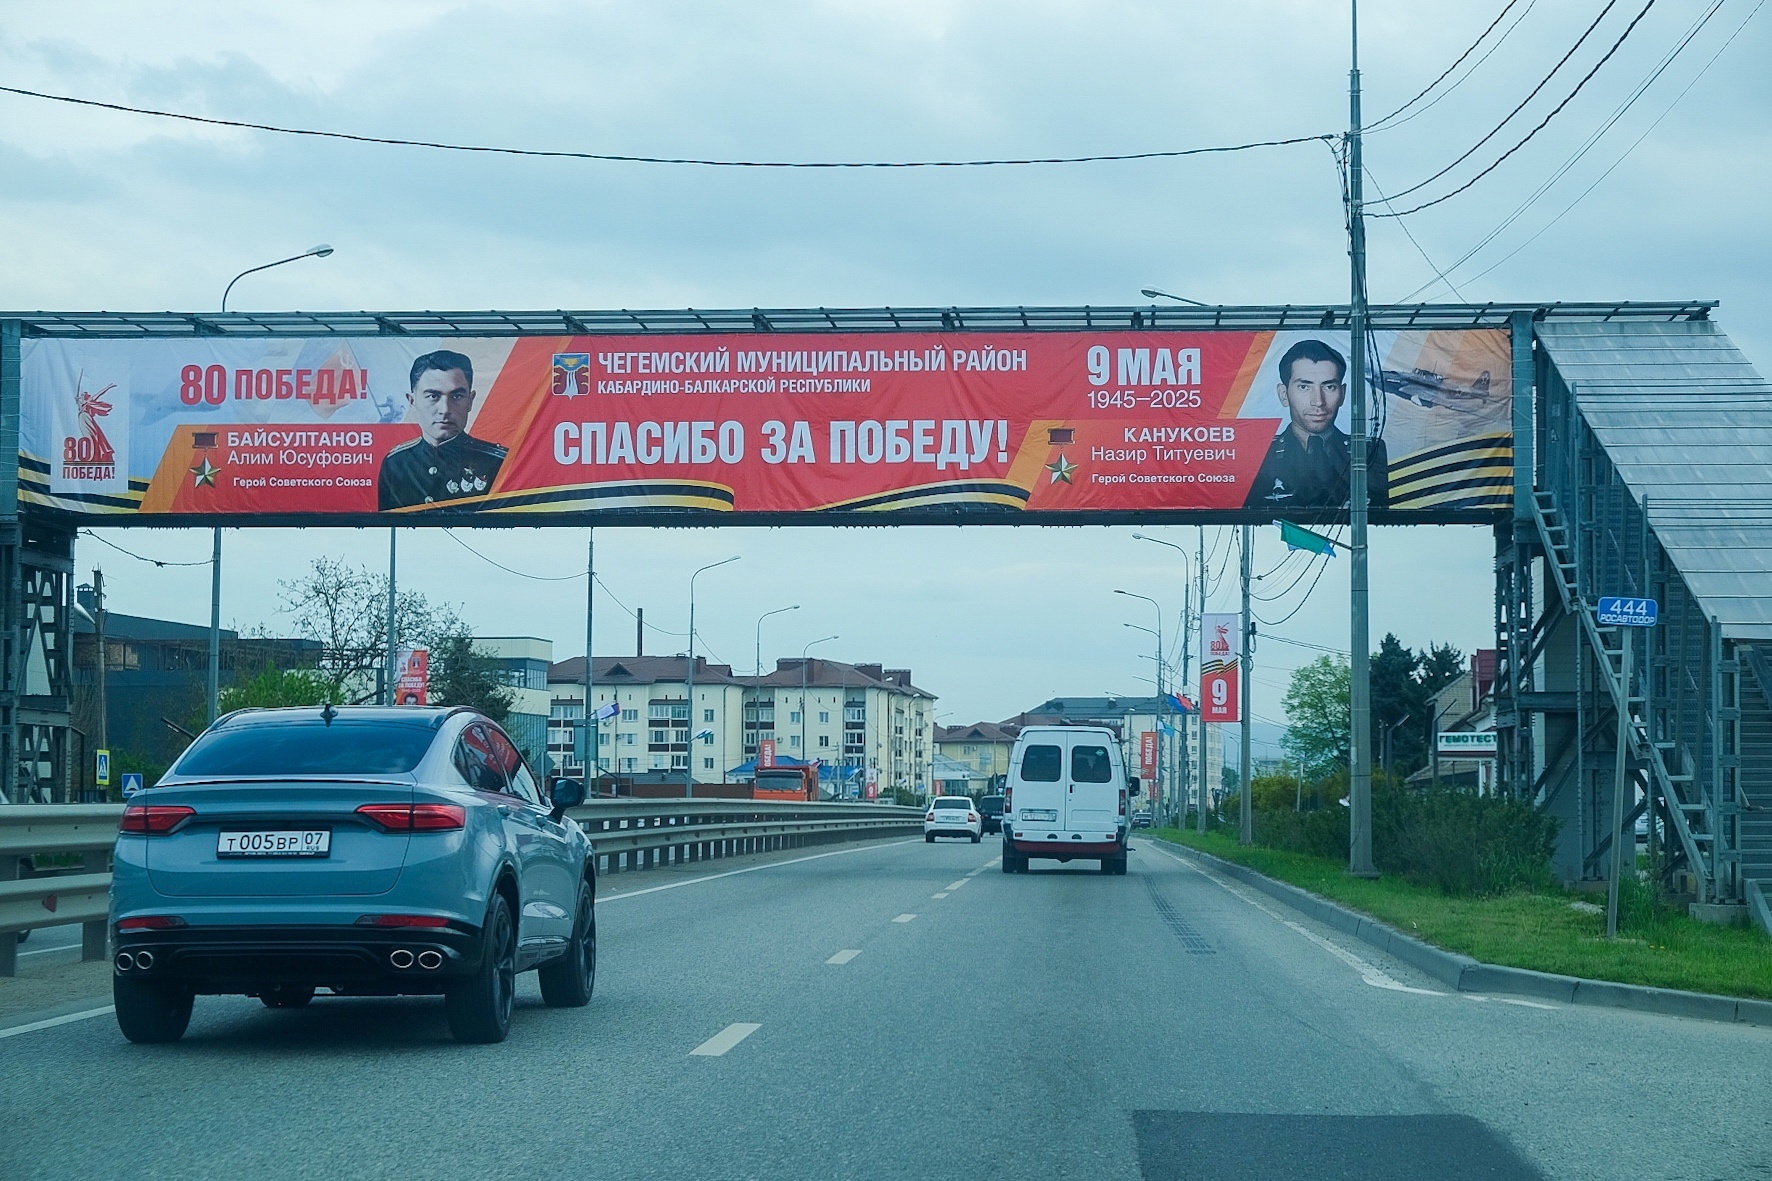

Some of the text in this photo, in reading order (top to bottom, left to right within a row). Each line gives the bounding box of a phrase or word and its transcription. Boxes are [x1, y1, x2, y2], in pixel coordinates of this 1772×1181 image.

[598, 345, 1027, 376] ЧЕГЕМСКИЙ МУНИЦИПАЛЬНЫЙ РАЙОН
[1087, 345, 1202, 386] 9 МАЯ
[180, 364, 368, 405] 80 ПОБЕДА!
[598, 376, 871, 396] КАБАРДИНО-БАЛКАРСКОЙ РЕСПУБЛИКИ
[227, 428, 373, 447] БАЙСУЛТАНОВ
[1124, 427, 1236, 443] КАНУКОЕВ
[63, 436, 91, 462] 80
[553, 420, 1009, 470] СПАСИБО ЗА ПОБЕДУ!
[1091, 445, 1236, 464] Назир Титуевич
[227, 449, 373, 468] Алим Юсуфович
[62, 466, 116, 481] ПОБЕДА!
[233, 476, 373, 489] Герой Советского Союза
[1092, 473, 1236, 485] Герой Советского Союза
[1610, 599, 1648, 616] 444
[1600, 614, 1655, 624] РОСАВТОДОР
[1212, 678, 1228, 706] 9
[1144, 736, 1154, 765] ПОБЕДА!
[304, 832, 323, 845] 07
